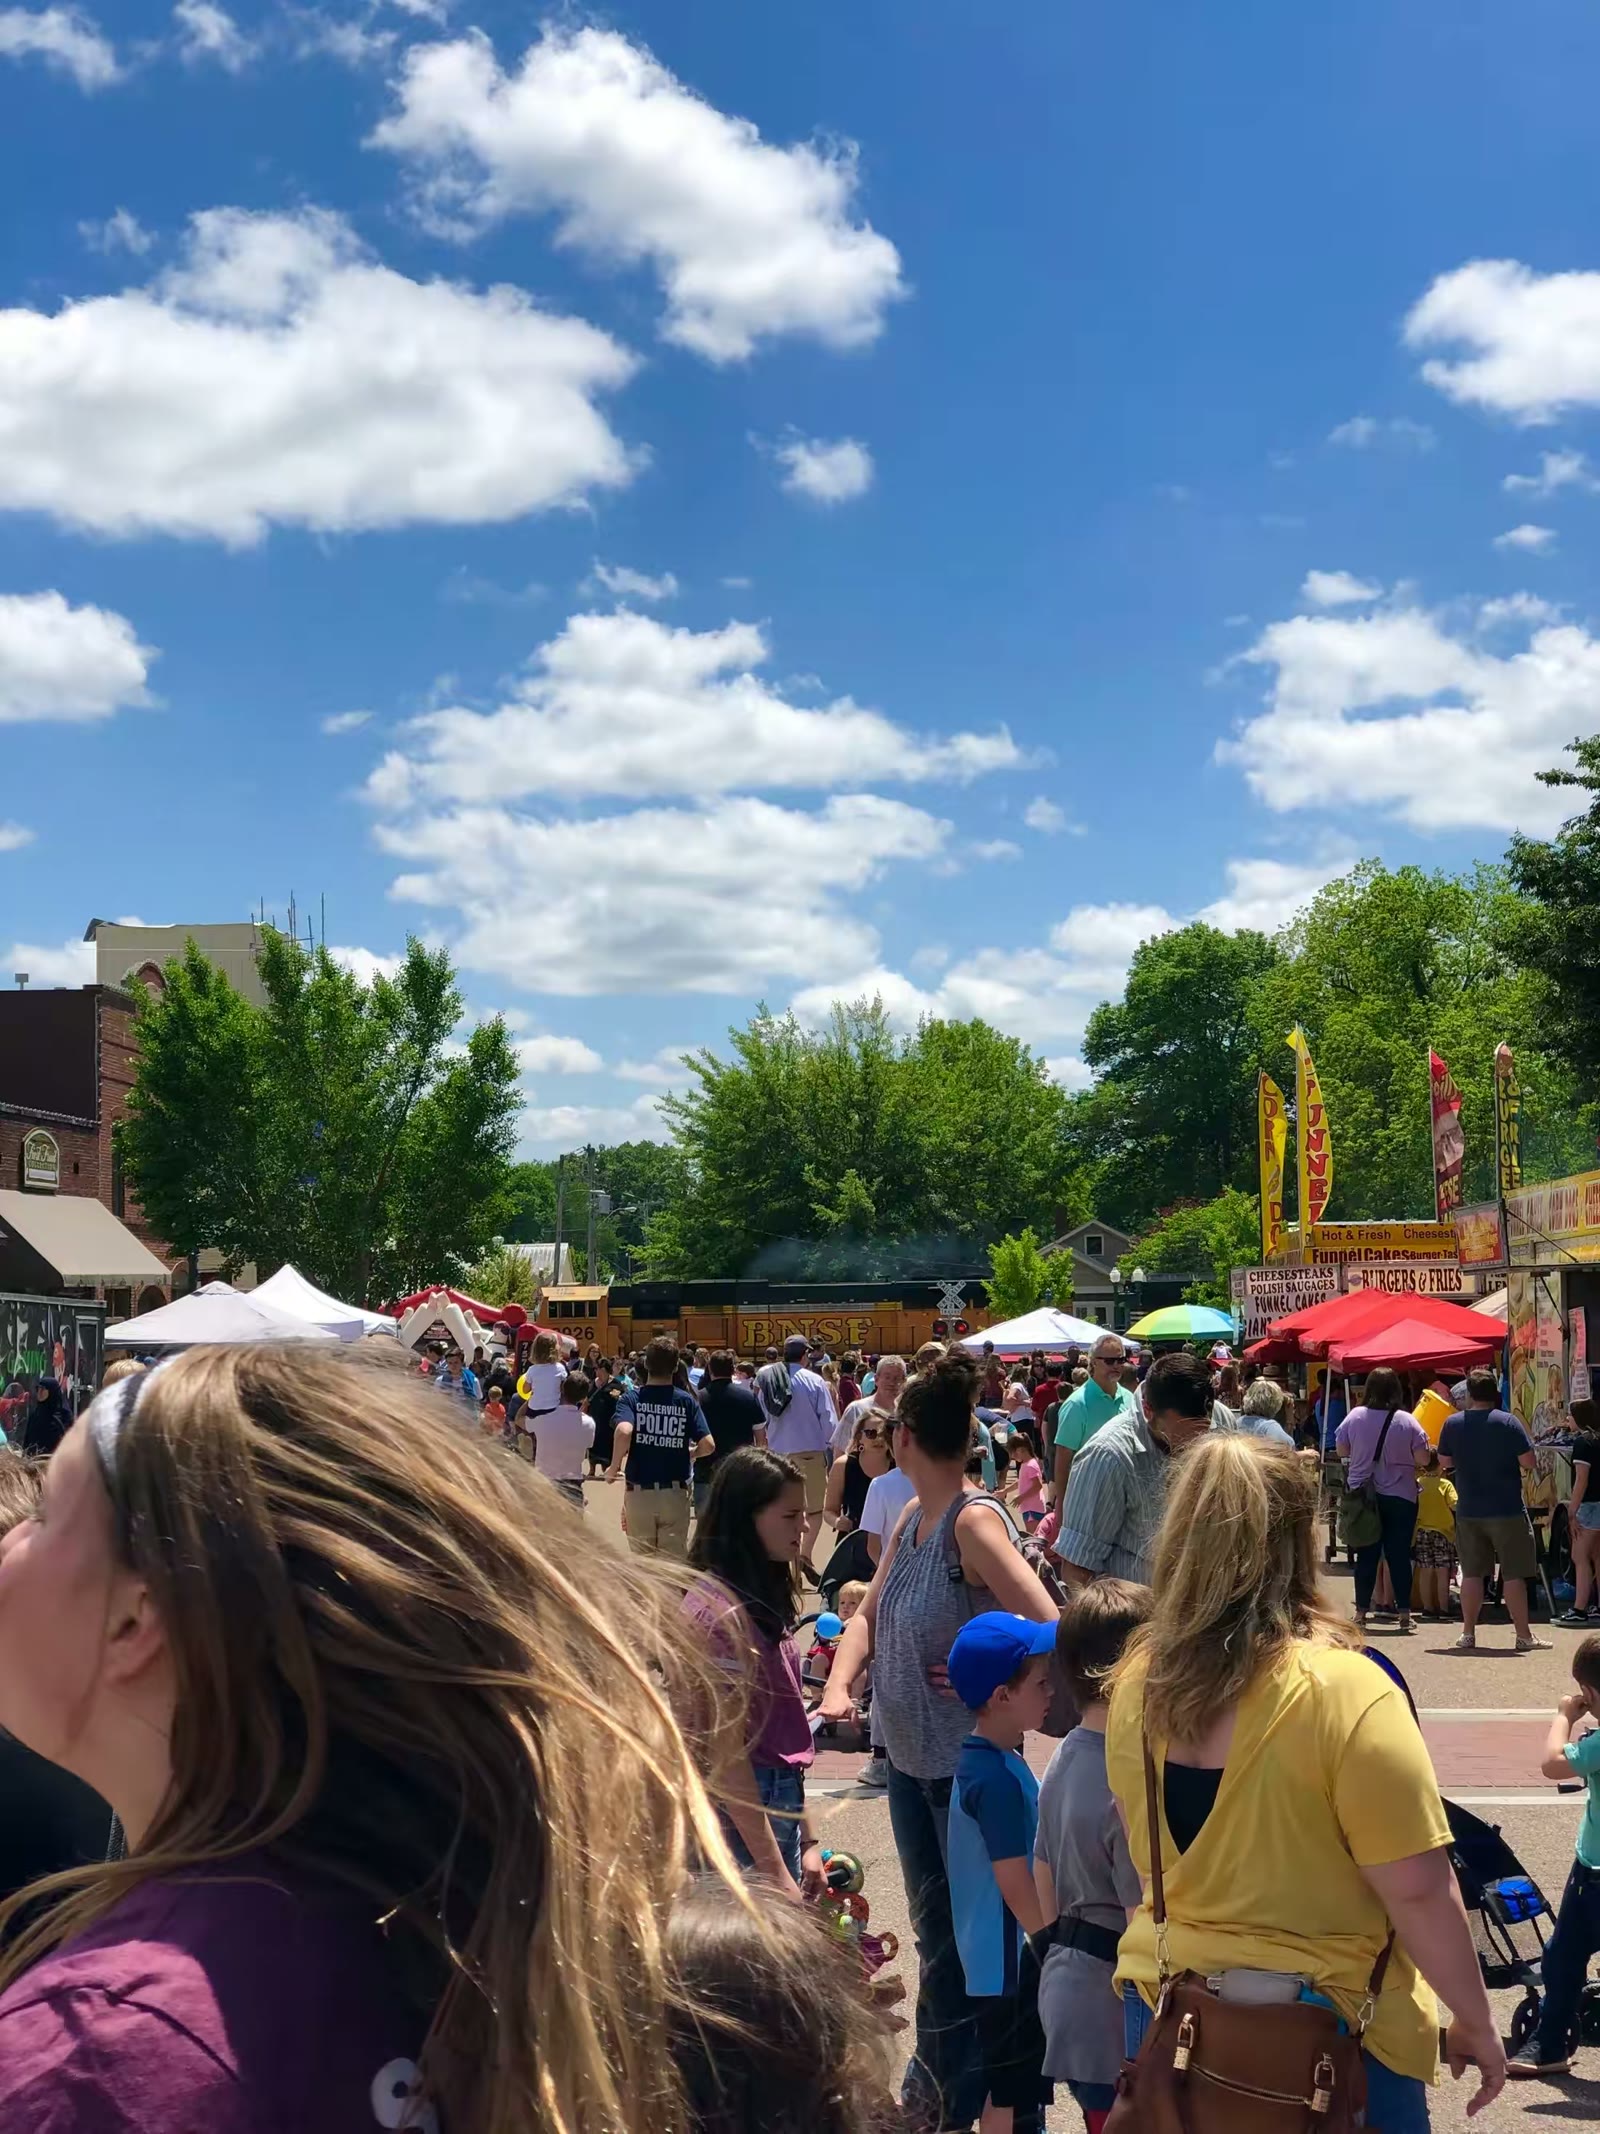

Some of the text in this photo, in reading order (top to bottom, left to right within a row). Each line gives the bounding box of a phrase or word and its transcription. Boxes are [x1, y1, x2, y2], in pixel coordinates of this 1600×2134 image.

[1322, 1229, 1391, 1241] Hot & Fresh
[1404, 1228, 1456, 1239] Cheesest
[1312, 1247, 1362, 1264] Funnel
[1364, 1247, 1410, 1261] Cakes
[1249, 1267, 1334, 1283] CHEESESTEAKS
[1362, 1268, 1462, 1293] BURGERS & FRIES
[1251, 1282, 1284, 1295] POLISH
[1285, 1279, 1335, 1294] SAUGAGES
[1254, 1292, 1326, 1314] FUNNEL CAKES
[743, 1317, 873, 1347] BNSF
[636, 1402, 687, 1417] COLLIERVILLE
[636, 1413, 687, 1437] POLICE
[636, 1433, 684, 1449] EXPLORER
